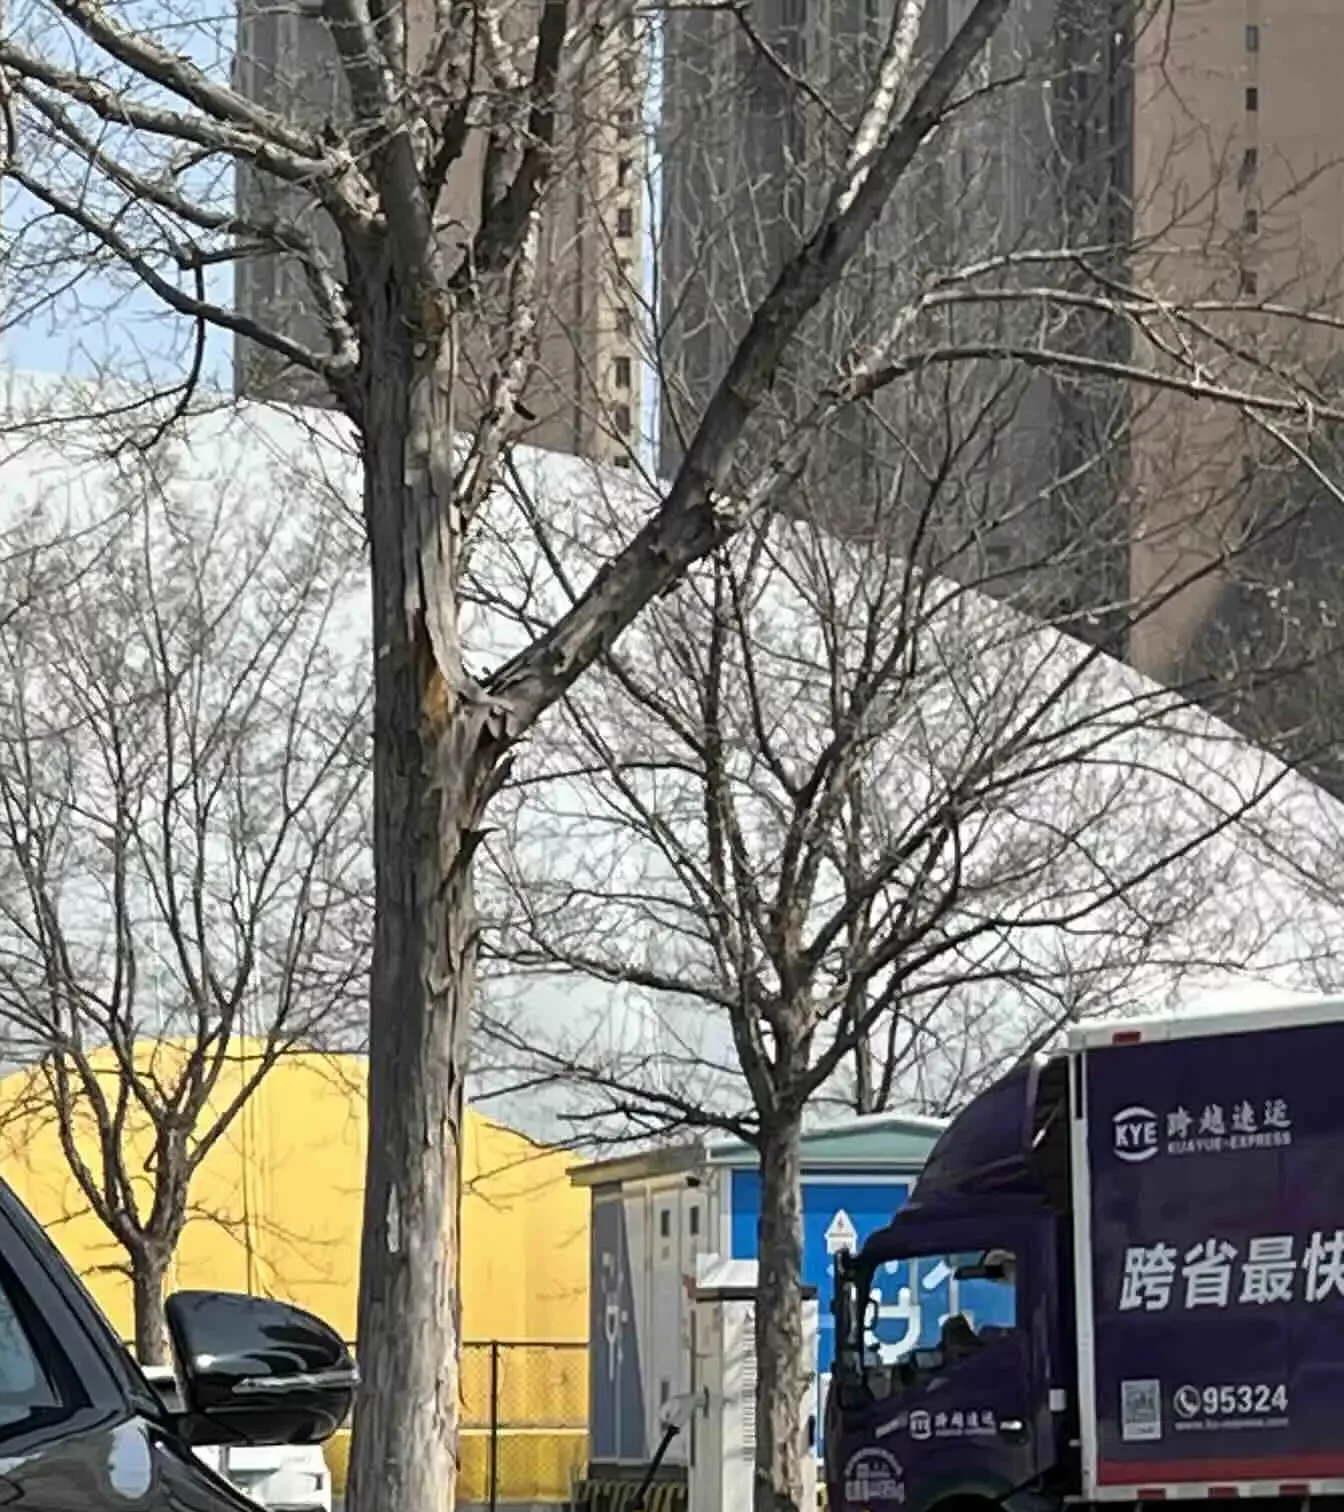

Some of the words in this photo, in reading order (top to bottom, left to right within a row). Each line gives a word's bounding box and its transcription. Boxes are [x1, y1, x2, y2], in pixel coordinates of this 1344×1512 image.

[1115, 1122, 1158, 1147] KYE
[1119, 1230, 1344, 1311] 跨省最快
[1203, 1384, 1289, 1414] 95324
